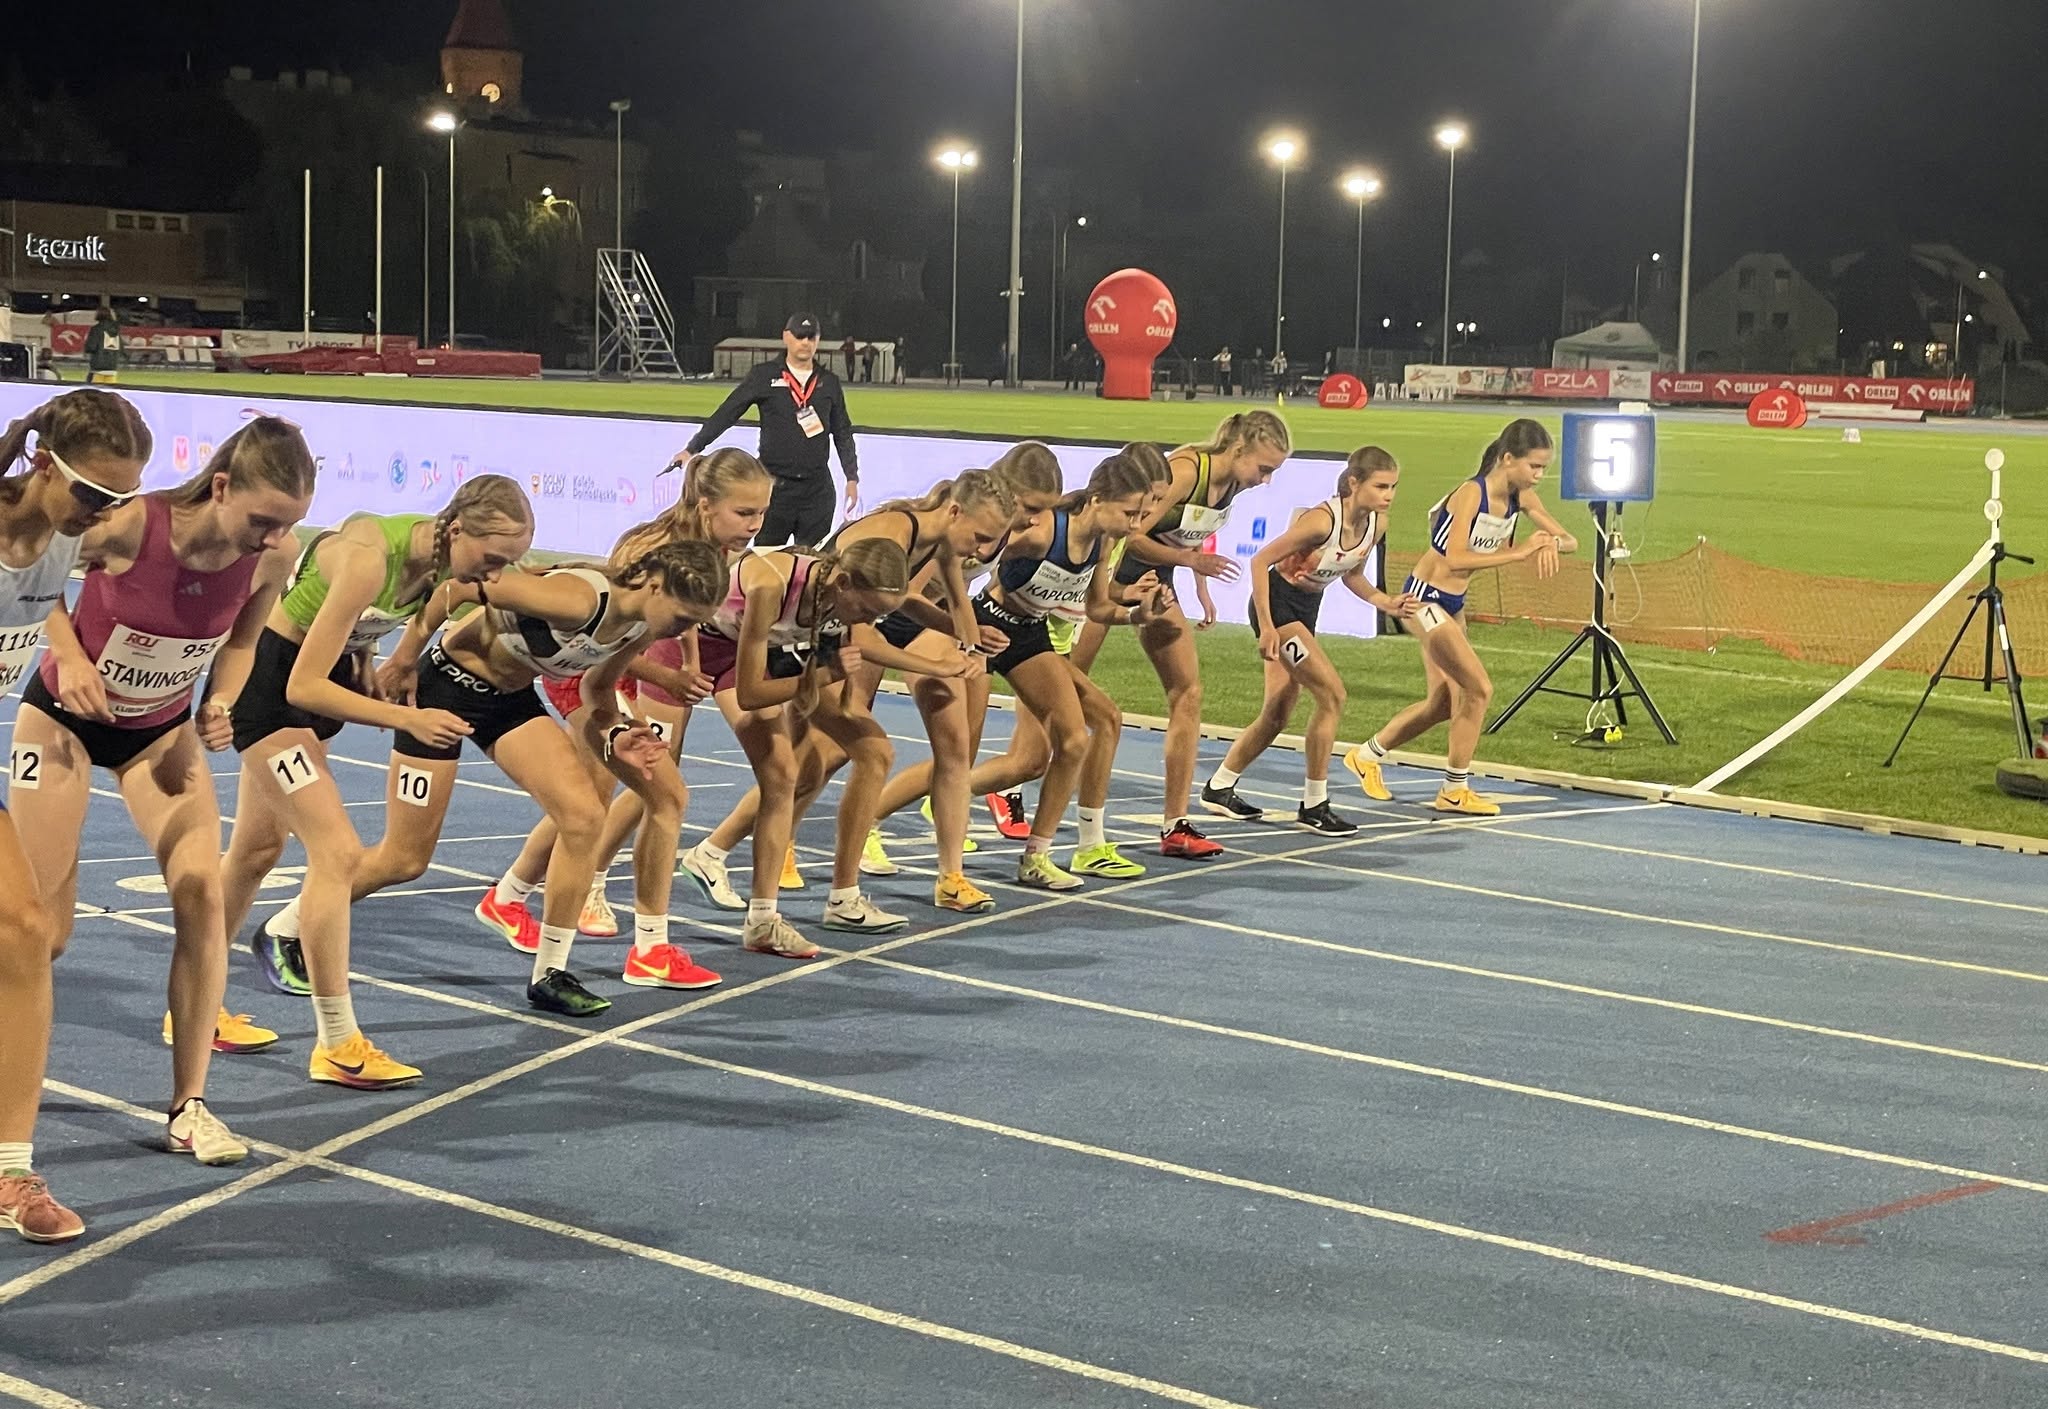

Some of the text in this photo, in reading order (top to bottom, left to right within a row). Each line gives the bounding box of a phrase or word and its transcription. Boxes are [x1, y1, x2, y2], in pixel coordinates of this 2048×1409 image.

[26, 233, 107, 264] Łącznik
[1088, 322, 1120, 335] ORLEN
[1543, 373, 1598, 389] PZLA
[1676, 381, 1702, 392] ORLEN
[1797, 383, 1834, 397] ORLEN
[1327, 394, 1349, 402] ORLEN
[1866, 386, 1897, 399] ORLEN
[1928, 387, 1971, 401] ORLEN
[1759, 410, 1785, 421] ORLEN
[1591, 422, 1636, 491] 5
[983, 600, 1019, 625] NIKE
[1425, 607, 1437, 625] 1
[0, 626, 41, 652] 1116
[181, 639, 220, 660] 955
[1285, 641, 1305, 664] 2
[440, 663, 490, 693] PRO
[11, 750, 40, 782] 12
[276, 751, 312, 786] 11
[399, 772, 429, 800] 10
